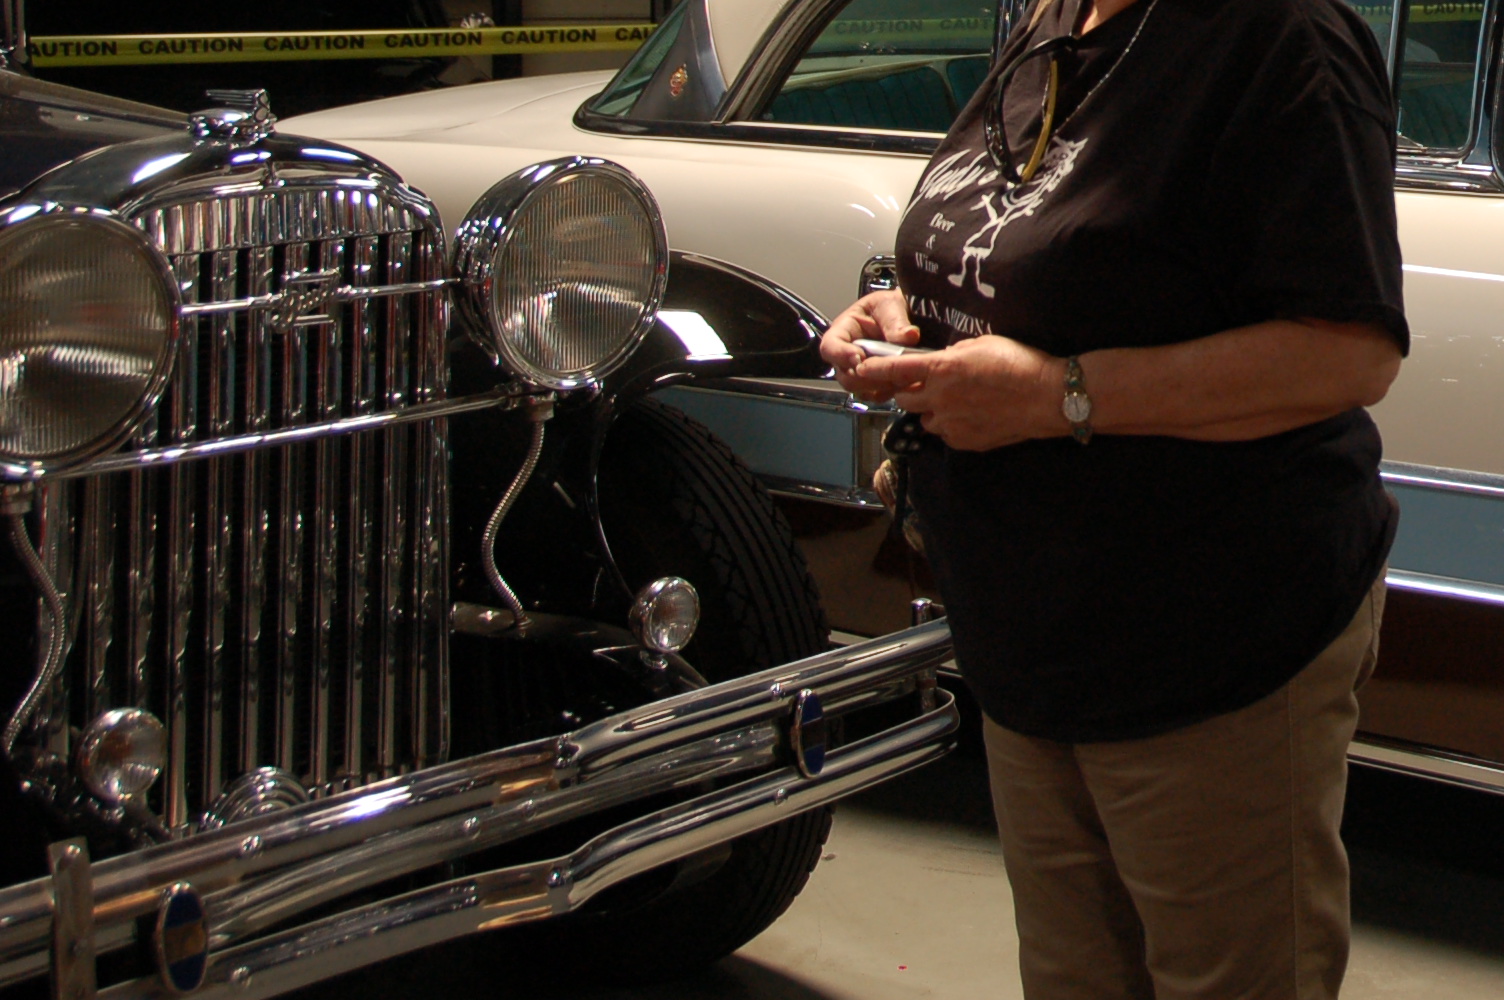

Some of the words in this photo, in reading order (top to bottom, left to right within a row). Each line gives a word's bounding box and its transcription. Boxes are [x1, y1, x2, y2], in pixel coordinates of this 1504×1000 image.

[1423, 3, 1483, 15] CAUTIO
[834, 20, 923, 35] CAUTION
[939, 16, 993, 31] CAUT
[30, 41, 118, 57] AUTION
[139, 37, 244, 55] CAUTION
[263, 34, 365, 51] CAUTION
[384, 31, 483, 48] CAUTION
[501, 28, 596, 44] CAUTION
[929, 212, 956, 232] Beer
[915, 251, 939, 274] Wine
[943, 305, 993, 337] ARIZONA
